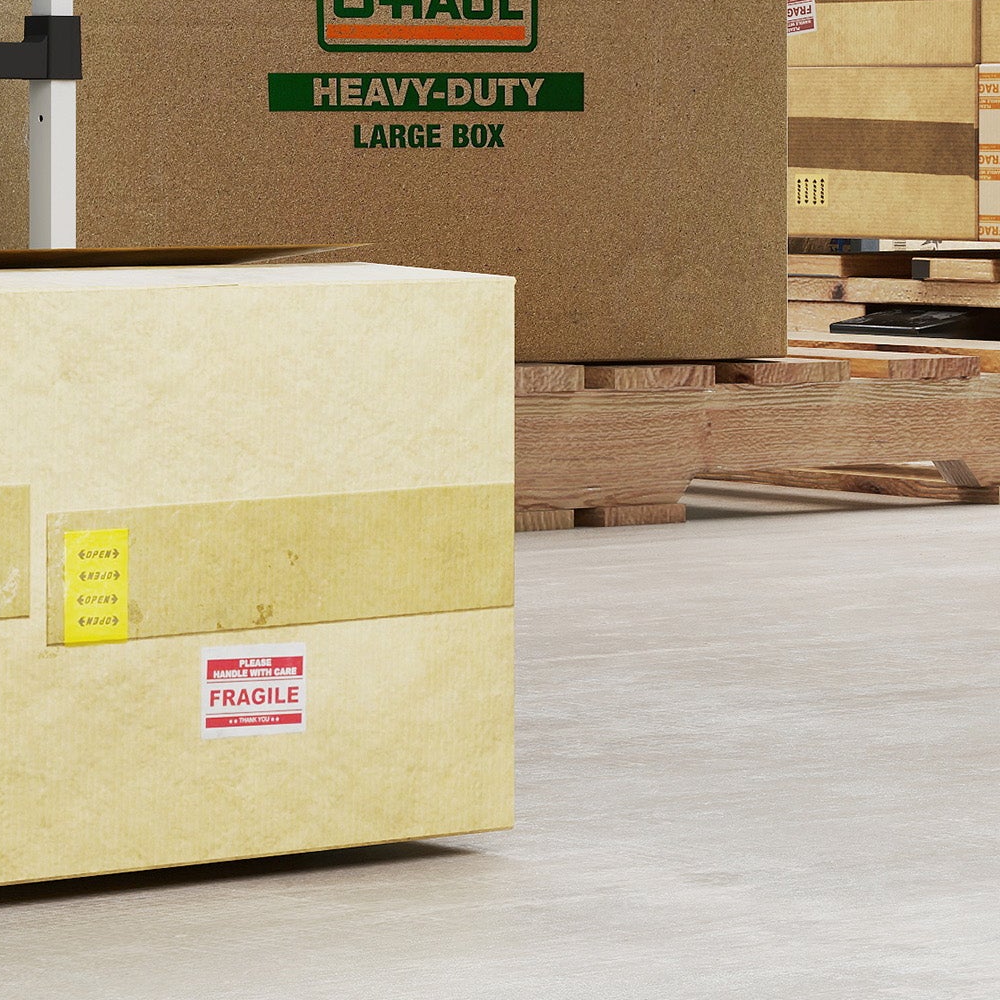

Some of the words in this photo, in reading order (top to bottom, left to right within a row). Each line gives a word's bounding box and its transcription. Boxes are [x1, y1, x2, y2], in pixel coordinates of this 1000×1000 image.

[788, 4, 812, 17] FRAG
[312, 76, 545, 107] HEAVY-DUTY
[353, 124, 442, 148] LARGE
[452, 124, 505, 148] BOX
[85, 549, 111, 559] OPEN
[87, 571, 113, 580] OPEN
[84, 594, 110, 605] OPEN
[85, 616, 112, 626] OPEN
[238, 659, 272, 667] PLEASE
[213, 668, 248, 678] HANDLE
[249, 668, 272, 677] WITH
[274, 667, 297, 676] CARE
[209, 686, 299, 707] FRAGILE
